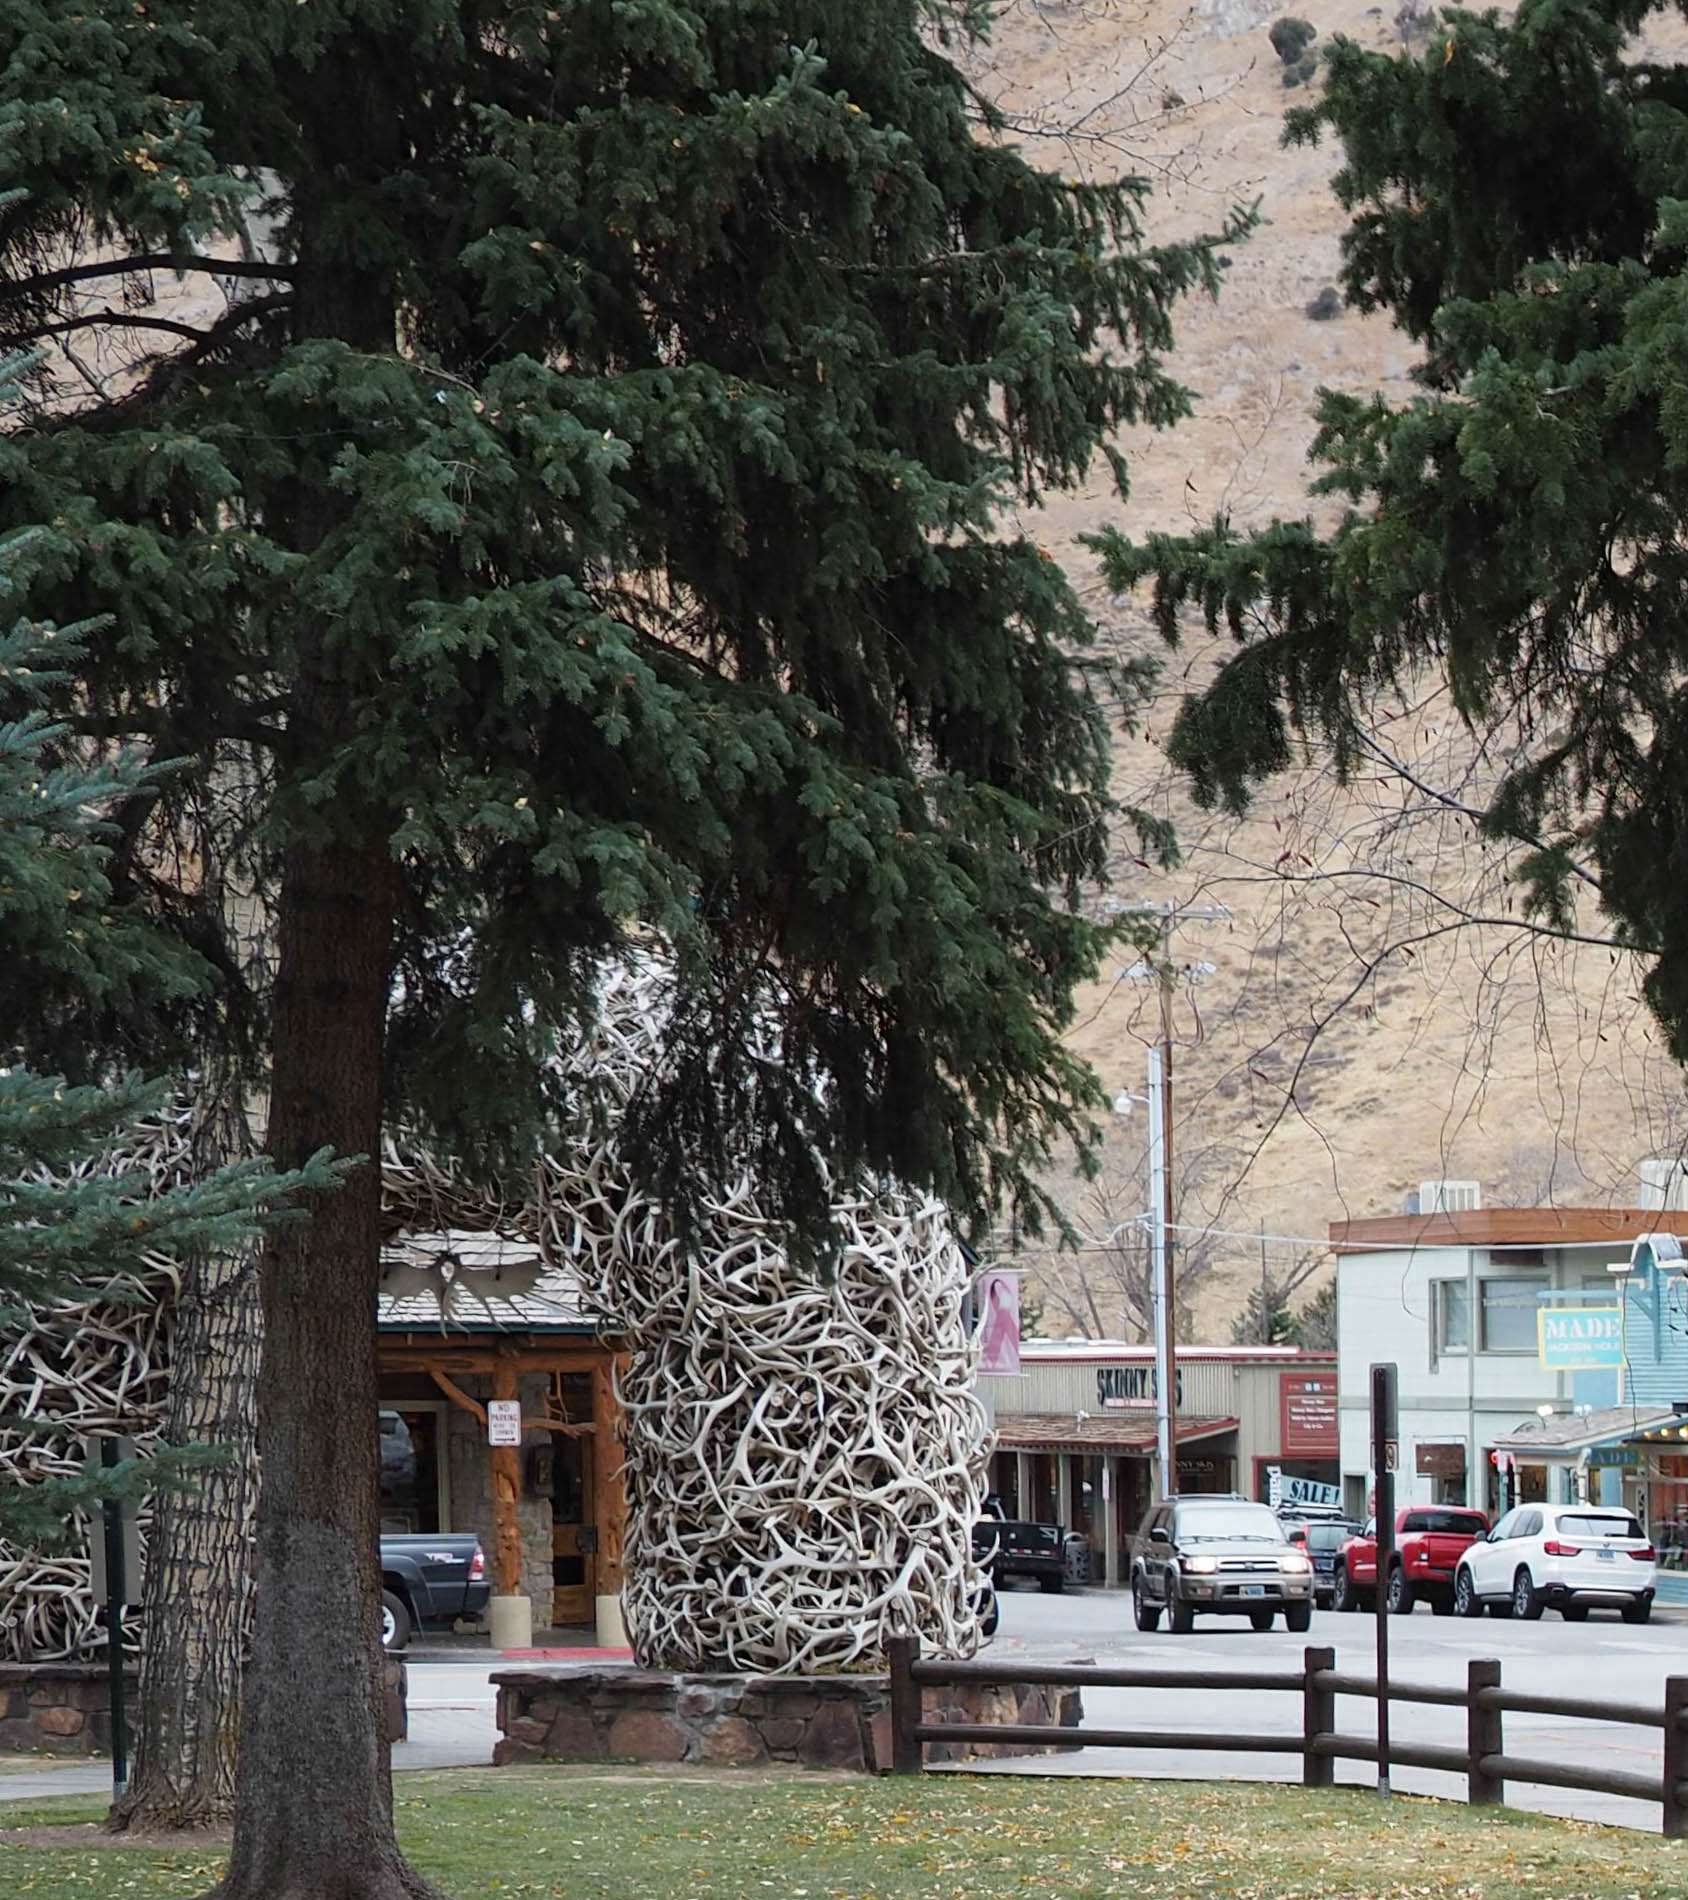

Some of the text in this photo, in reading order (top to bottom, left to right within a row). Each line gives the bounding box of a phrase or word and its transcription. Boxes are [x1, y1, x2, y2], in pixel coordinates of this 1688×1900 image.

[1546, 1318, 1620, 1338] MADE
[1097, 1367, 1182, 1407] SKINNY SS
